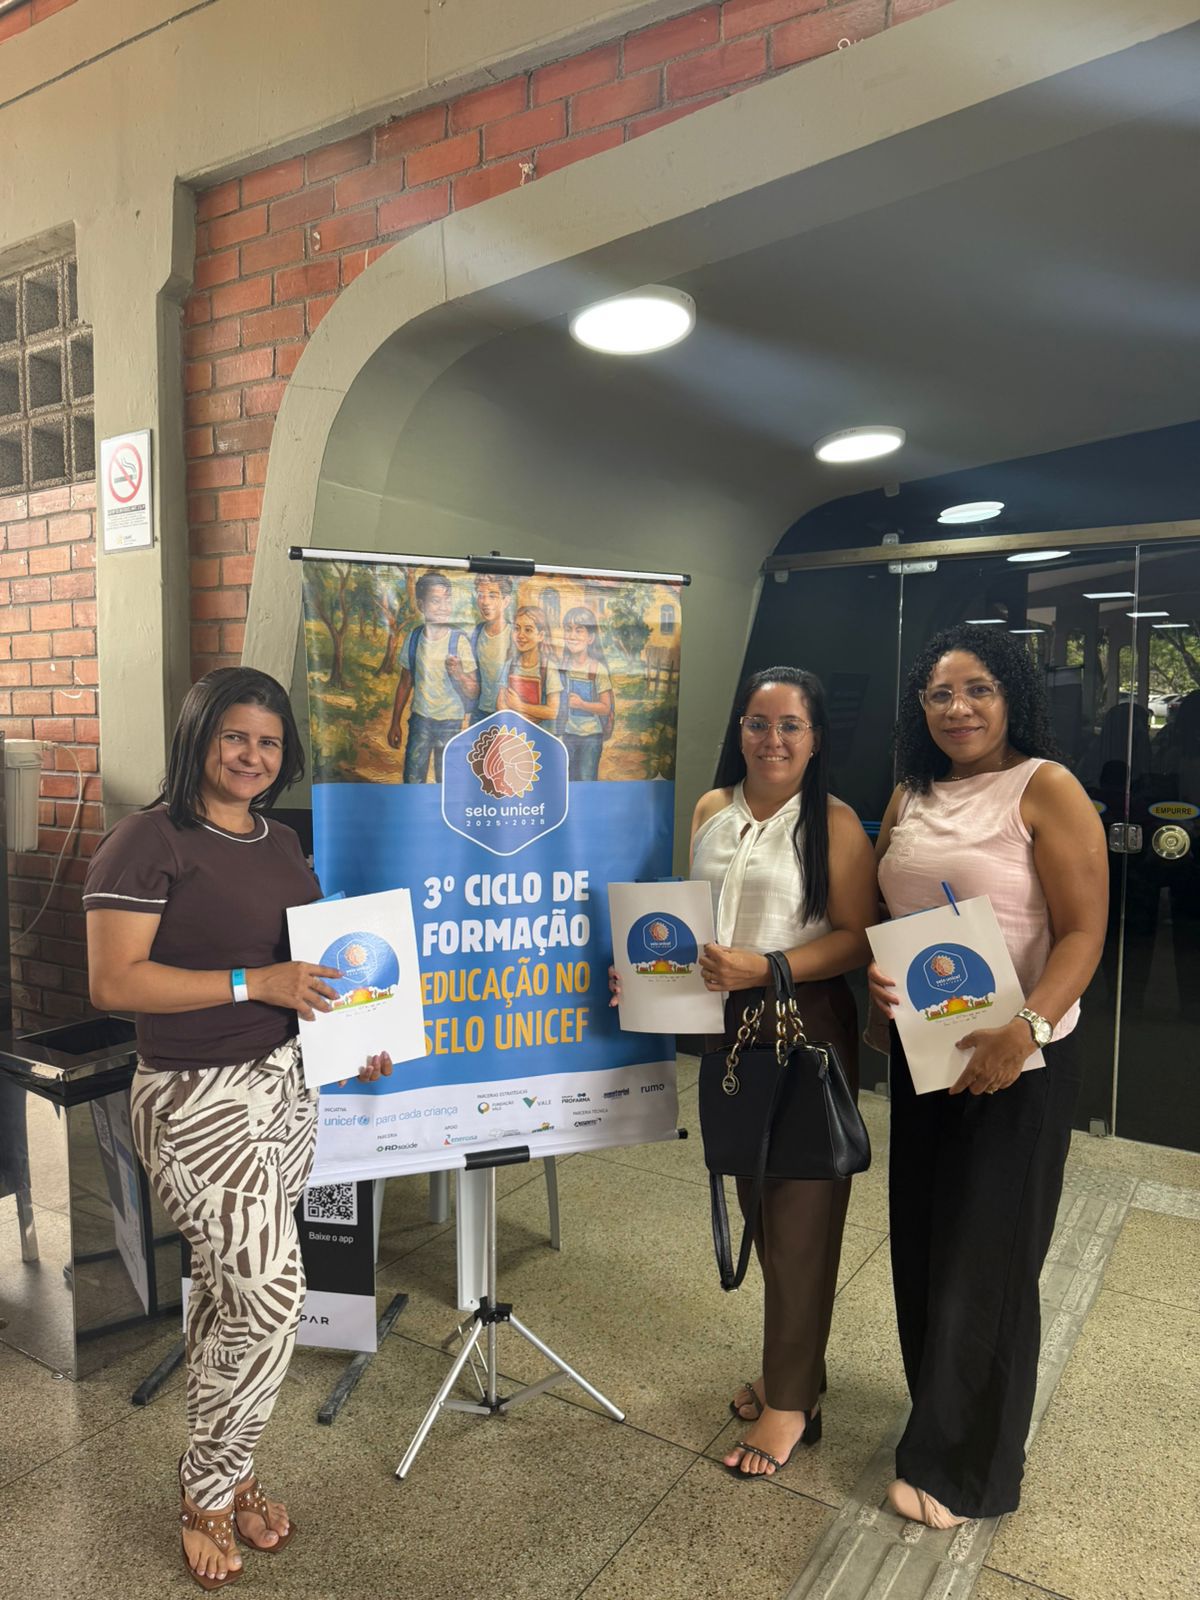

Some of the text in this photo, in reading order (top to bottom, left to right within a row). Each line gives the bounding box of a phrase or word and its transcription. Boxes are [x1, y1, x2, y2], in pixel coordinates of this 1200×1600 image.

[465, 803, 545, 817] selo unicef
[1155, 806, 1192, 815] EMPURRE
[464, 872, 542, 907] CICLO
[552, 870, 589, 902] DE
[422, 908, 590, 957] FORMAÇÃO
[420, 956, 590, 1008] EDUCAÇÃO NO
[424, 1007, 589, 1056] SELO UNICEF
[641, 1083, 665, 1094] rumo
[324, 1105, 458, 1127] unicef para cada criança
[308, 1231, 354, 1244] Baixe o app
